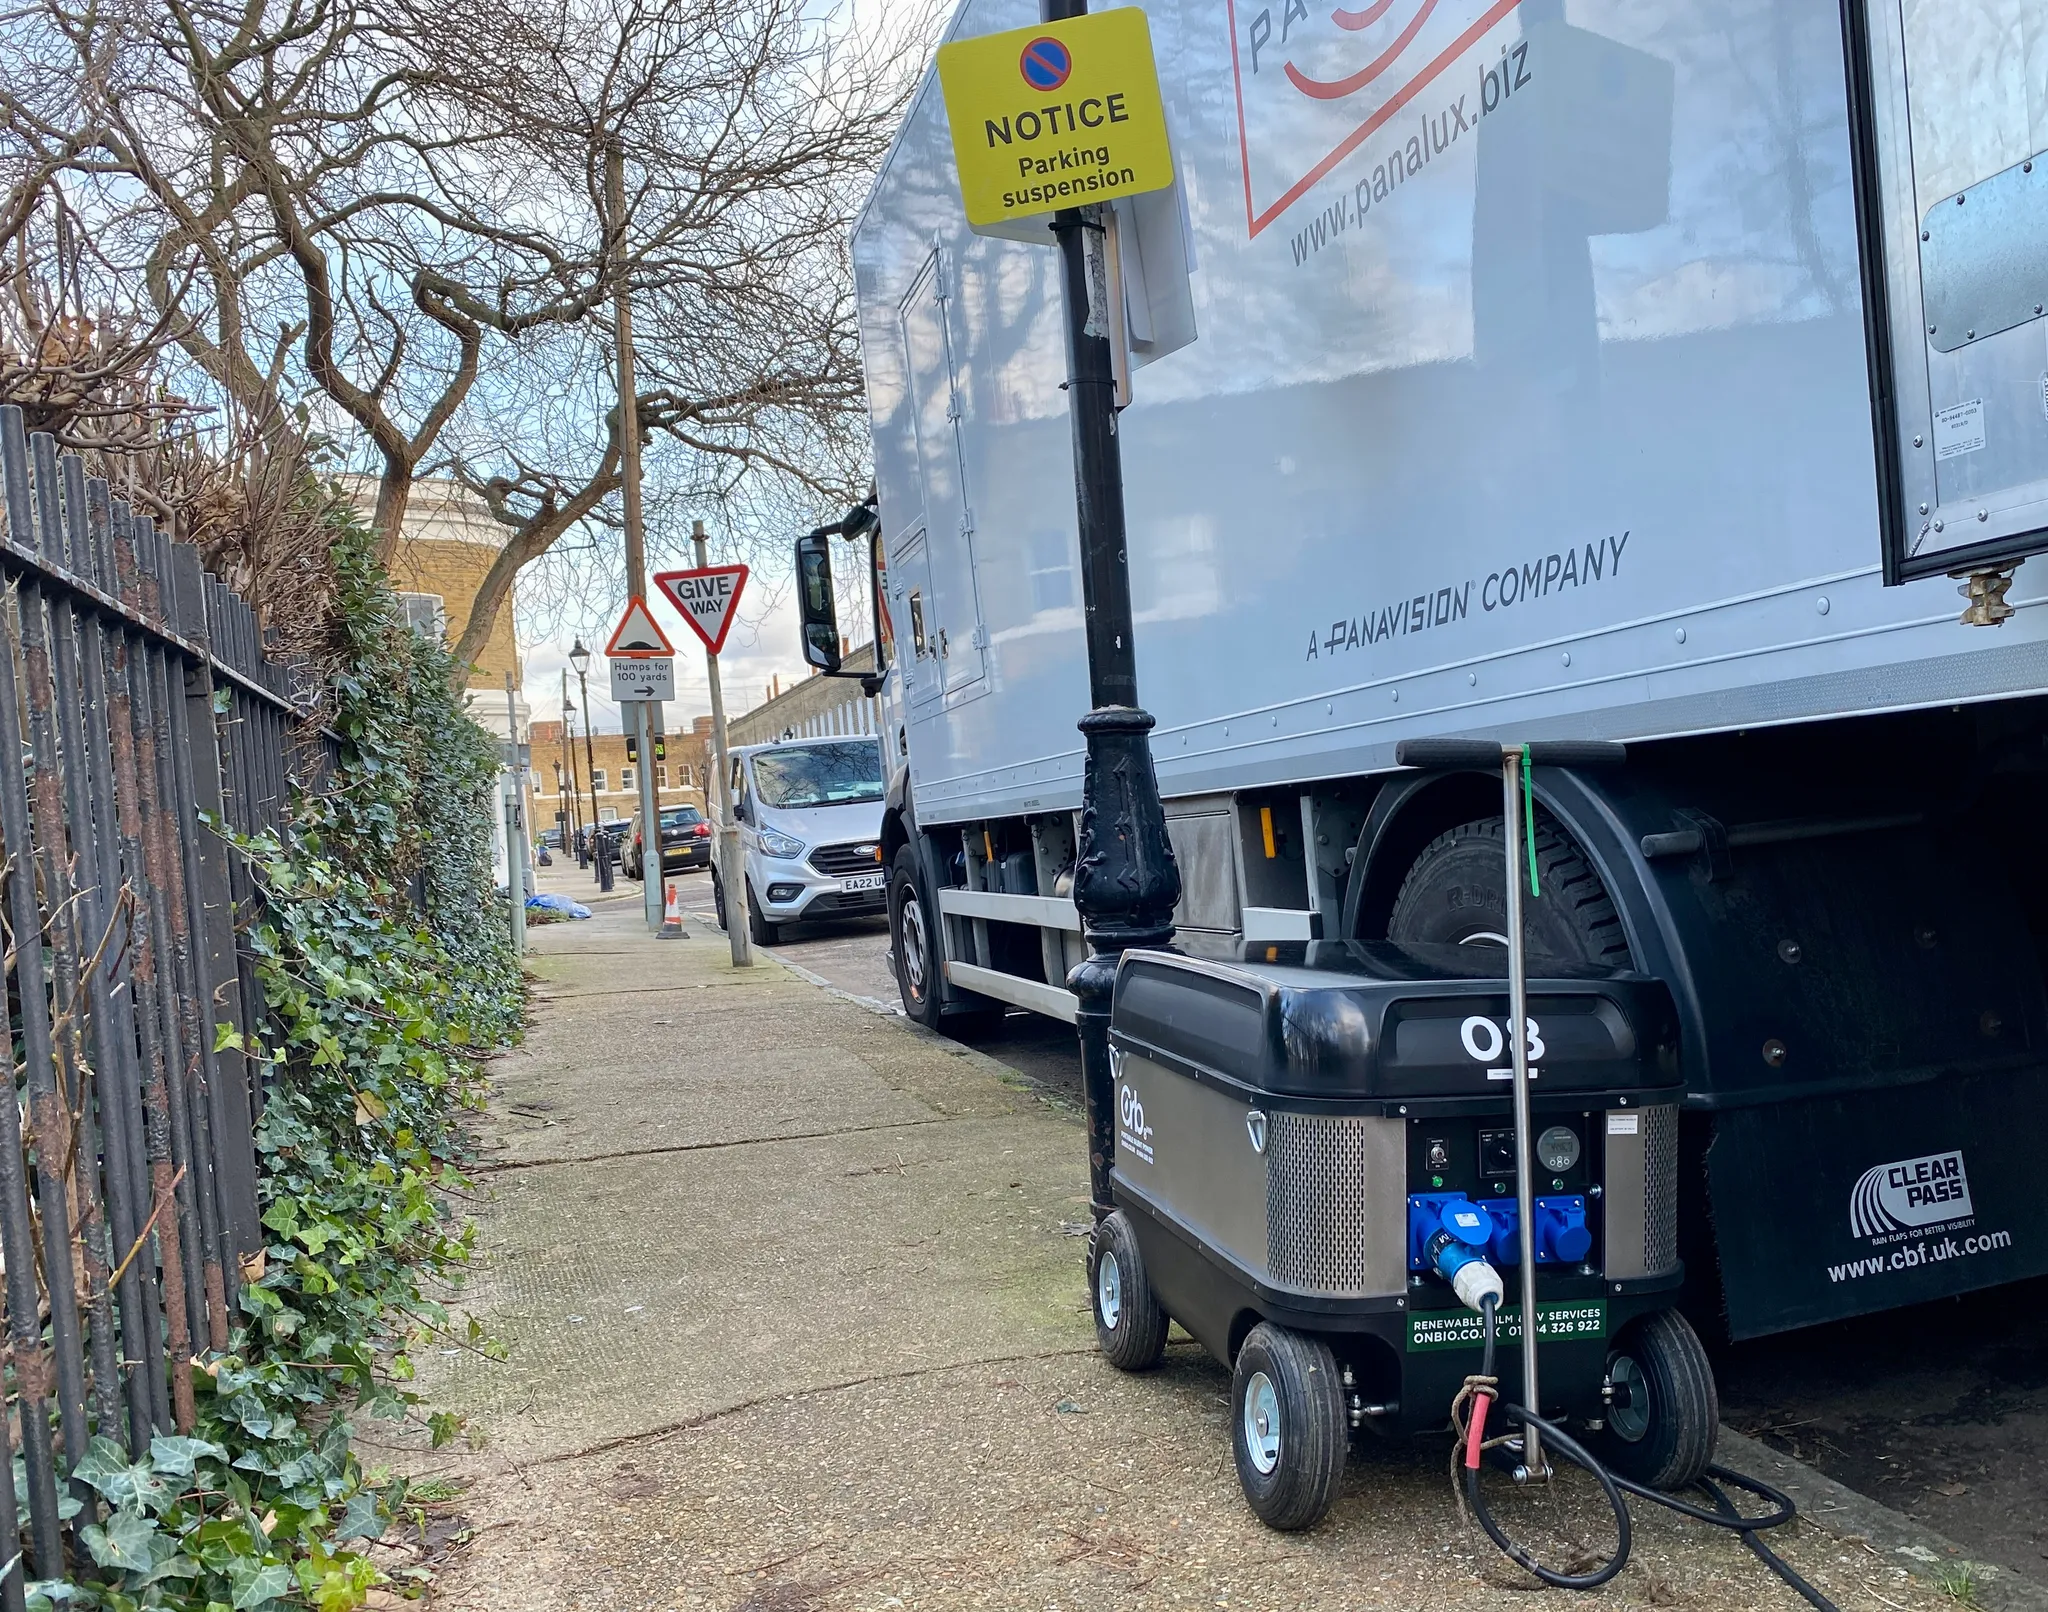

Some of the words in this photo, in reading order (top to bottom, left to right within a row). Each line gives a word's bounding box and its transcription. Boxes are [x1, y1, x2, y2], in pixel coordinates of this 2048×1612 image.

[1249, 0, 1309, 75] PA
[984, 93, 1129, 148] NOTICE
[1018, 146, 1110, 178] Parking
[1290, 40, 1532, 267] www.panalux.biz
[1002, 166, 1135, 208] suspension
[677, 575, 732, 600] GIVE
[1306, 629, 1318, 662] A
[1481, 530, 1631, 612] COMPANY
[689, 599, 724, 615] WAY
[614, 662, 651, 673] Humps
[654, 662, 669, 671] for
[617, 673, 636, 681] 100
[640, 672, 667, 683] yards
[845, 878, 872, 890] EA22
[1887, 1156, 1960, 1189] CLEAR
[1906, 1178, 1964, 1209] PASS
[1872, 1236, 1888, 1246] RAIN
[1888, 1231, 1908, 1243] FLAPS
[1909, 1229, 1923, 1239] FOR
[1924, 1224, 1946, 1236] BETTER
[1946, 1218, 1976, 1231] VISIBILITY
[1827, 1229, 2012, 1284] www.cbf.uk.com
[1413, 1316, 1484, 1331] RENEWABLE
[1495, 1314, 1513, 1325] ILM
[1548, 1308, 1601, 1321] SERVICES
[1508, 1323, 1547, 1337] 014
[1551, 1321, 1574, 1334] 326
[1577, 1319, 1600, 1332] 922
